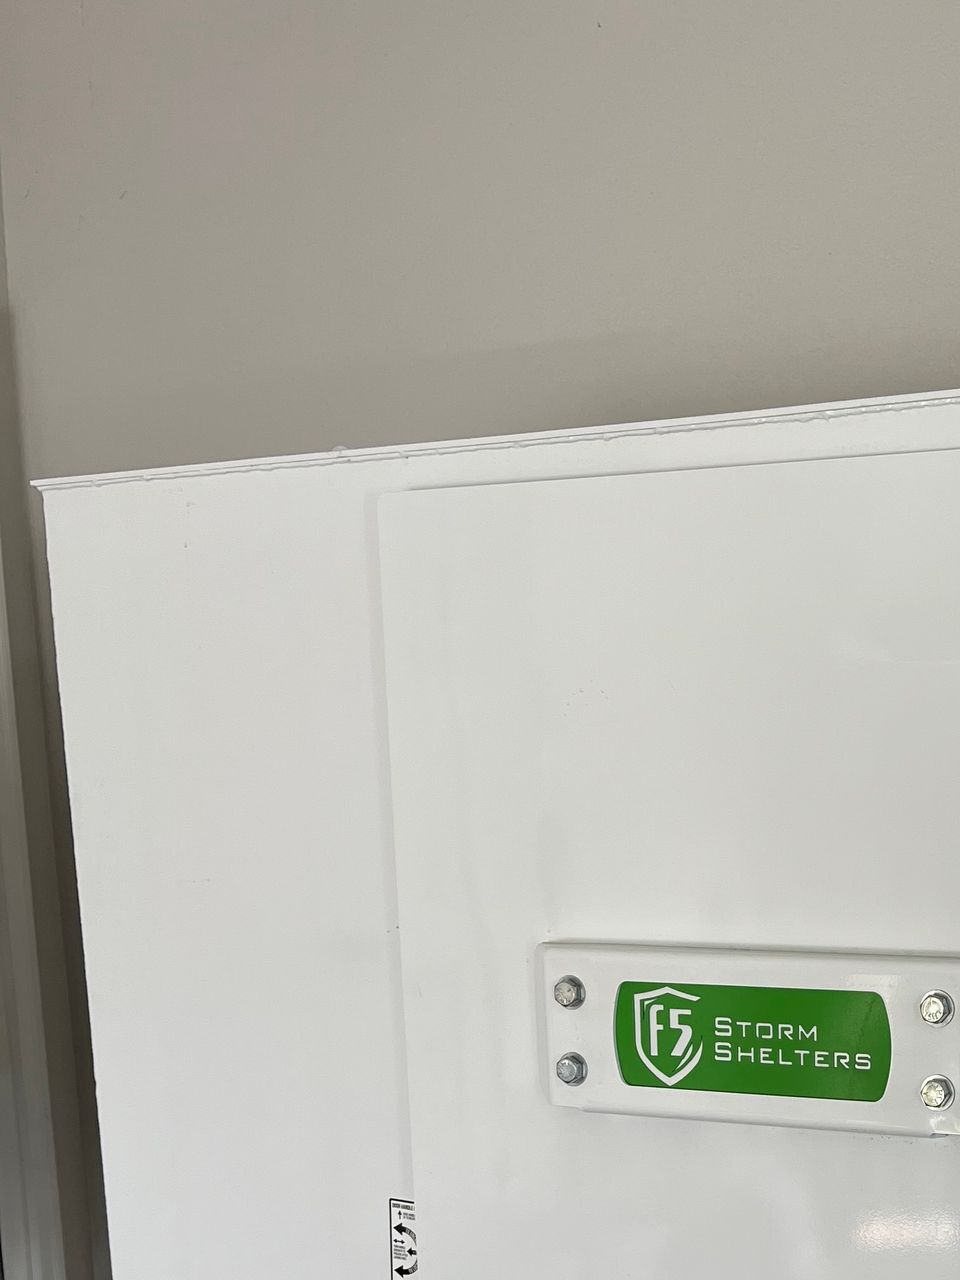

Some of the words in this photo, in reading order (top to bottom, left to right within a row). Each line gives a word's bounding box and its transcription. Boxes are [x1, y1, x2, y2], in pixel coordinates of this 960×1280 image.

[650, 1004, 692, 1057] F5
[714, 1017, 818, 1041] STORM
[714, 1042, 872, 1070] SHELTERS
